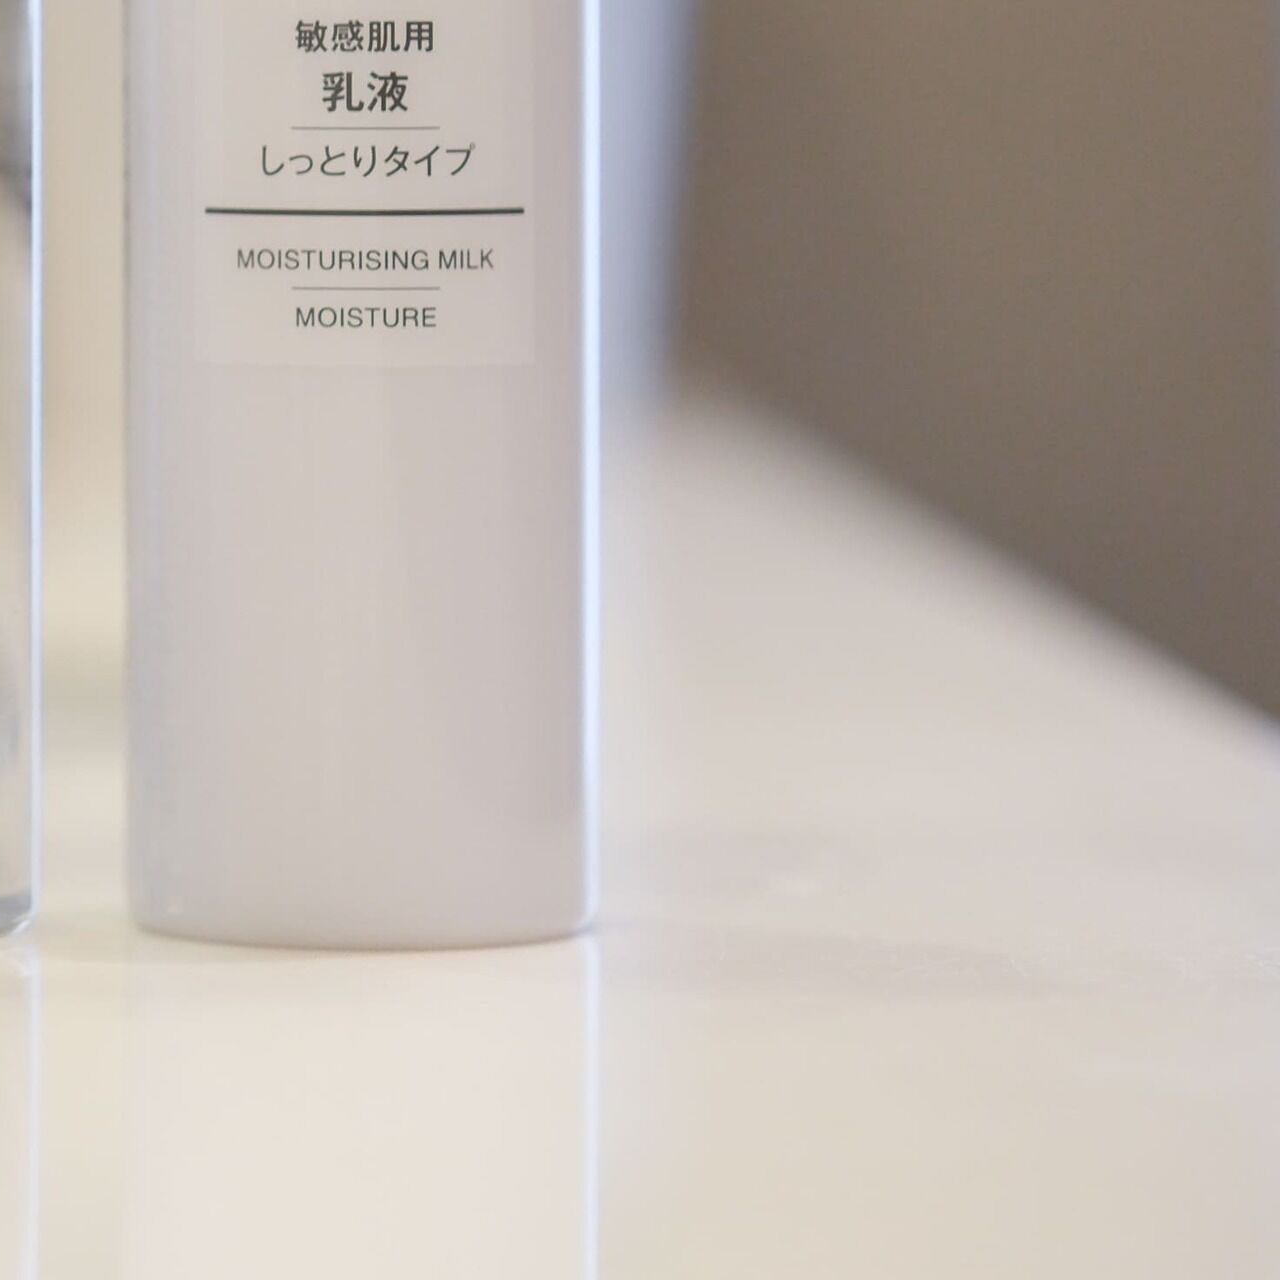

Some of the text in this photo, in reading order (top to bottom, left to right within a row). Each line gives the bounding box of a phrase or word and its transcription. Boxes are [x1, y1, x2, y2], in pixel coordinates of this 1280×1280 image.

[295, 20, 434, 53] 敏感肌用
[321, 71, 409, 112] 乳液
[260, 143, 476, 178] しっとりタイプ
[237, 248, 495, 271] MOISTURISING MILK
[295, 306, 437, 328] MOISTURE
